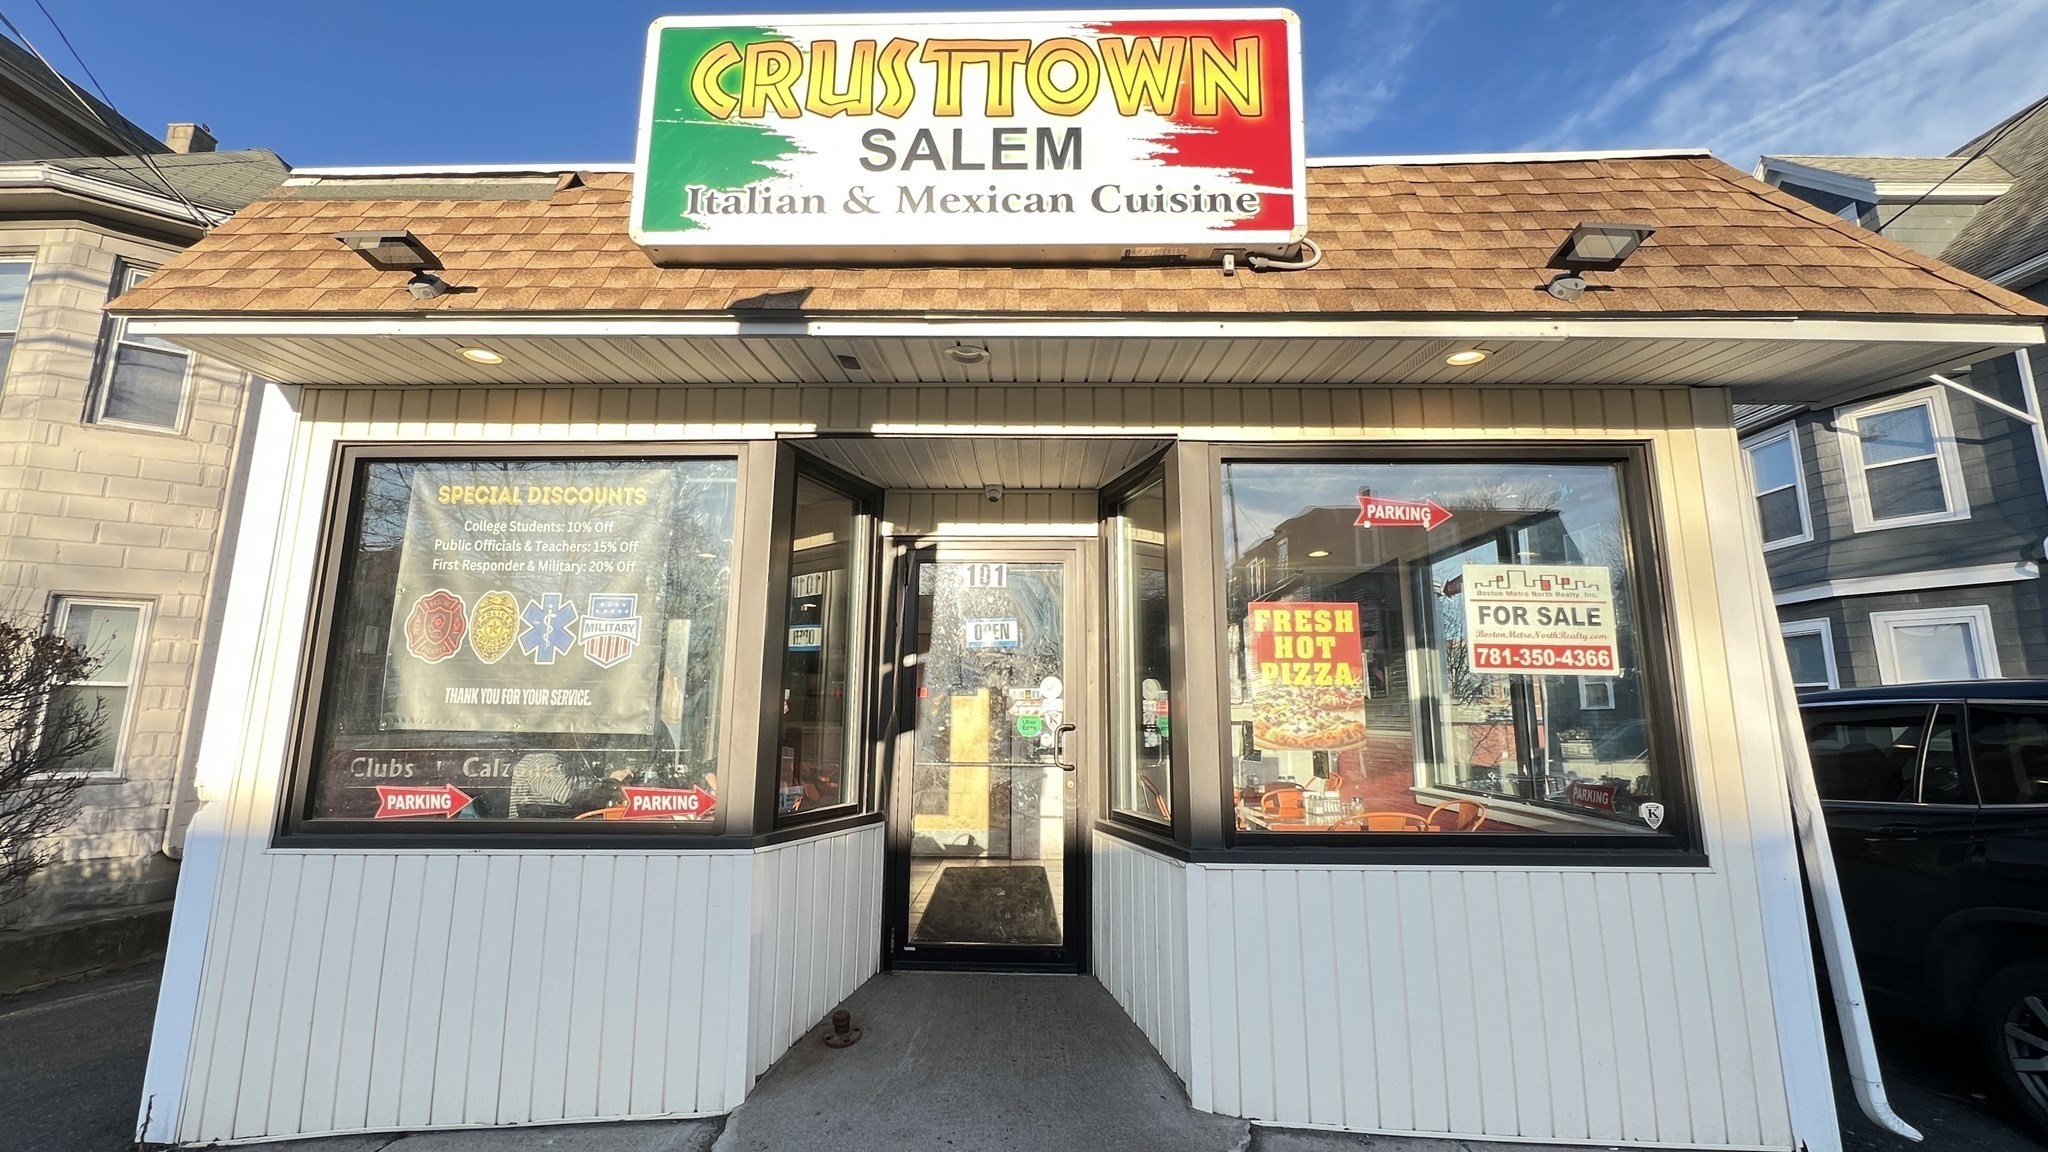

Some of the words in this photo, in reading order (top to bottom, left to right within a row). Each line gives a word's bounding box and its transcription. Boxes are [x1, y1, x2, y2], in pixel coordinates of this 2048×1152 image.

[690, 36, 1262, 118] CRUSTTOWN
[858, 127, 1082, 172] SALEM
[687, 186, 827, 215] Italian
[842, 185, 881, 215] &
[896, 184, 1076, 215] Mexican
[1091, 184, 1260, 214] Cuisine
[438, 485, 523, 505] SPECIAL
[527, 486, 649, 506] DISCOUNTS
[1367, 504, 1431, 521] PARKING
[464, 520, 508, 535] College
[509, 520, 566, 533] Students:
[567, 521, 592, 533] 10%
[594, 521, 615, 533] Off
[434, 539, 472, 552] Public
[474, 539, 522, 552] Officials
[524, 541, 533, 552] &
[535, 540, 591, 553] Teachers:
[593, 541, 617, 553] 15%
[619, 541, 640, 553] Off
[432, 559, 460, 571] First
[462, 559, 525, 574] Responder
[527, 560, 536, 572] &
[538, 560, 587, 575] Military:
[588, 561, 614, 573] 20%
[616, 561, 637, 573] Off
[967, 564, 1003, 587] 101
[1253, 609, 1355, 633] FRESH
[1478, 605, 1530, 625] FOR
[1537, 606, 1602, 627] SALE
[585, 623, 635, 633] MILITARY
[1274, 635, 1337, 659] HOT
[1476, 647, 1611, 667] 781-350-4366
[1260, 662, 1355, 687] PIZZA
[445, 687, 479, 704] THANK
[480, 688, 501, 705] YOU
[501, 688, 521, 705] FOR
[523, 688, 550, 705] YOUR
[551, 689, 592, 706] SERVICE.
[351, 756, 415, 778] Clubs
[387, 794, 451, 810] PARKING
[633, 795, 699, 811] PARKING
[1572, 786, 1609, 805] PARKING
